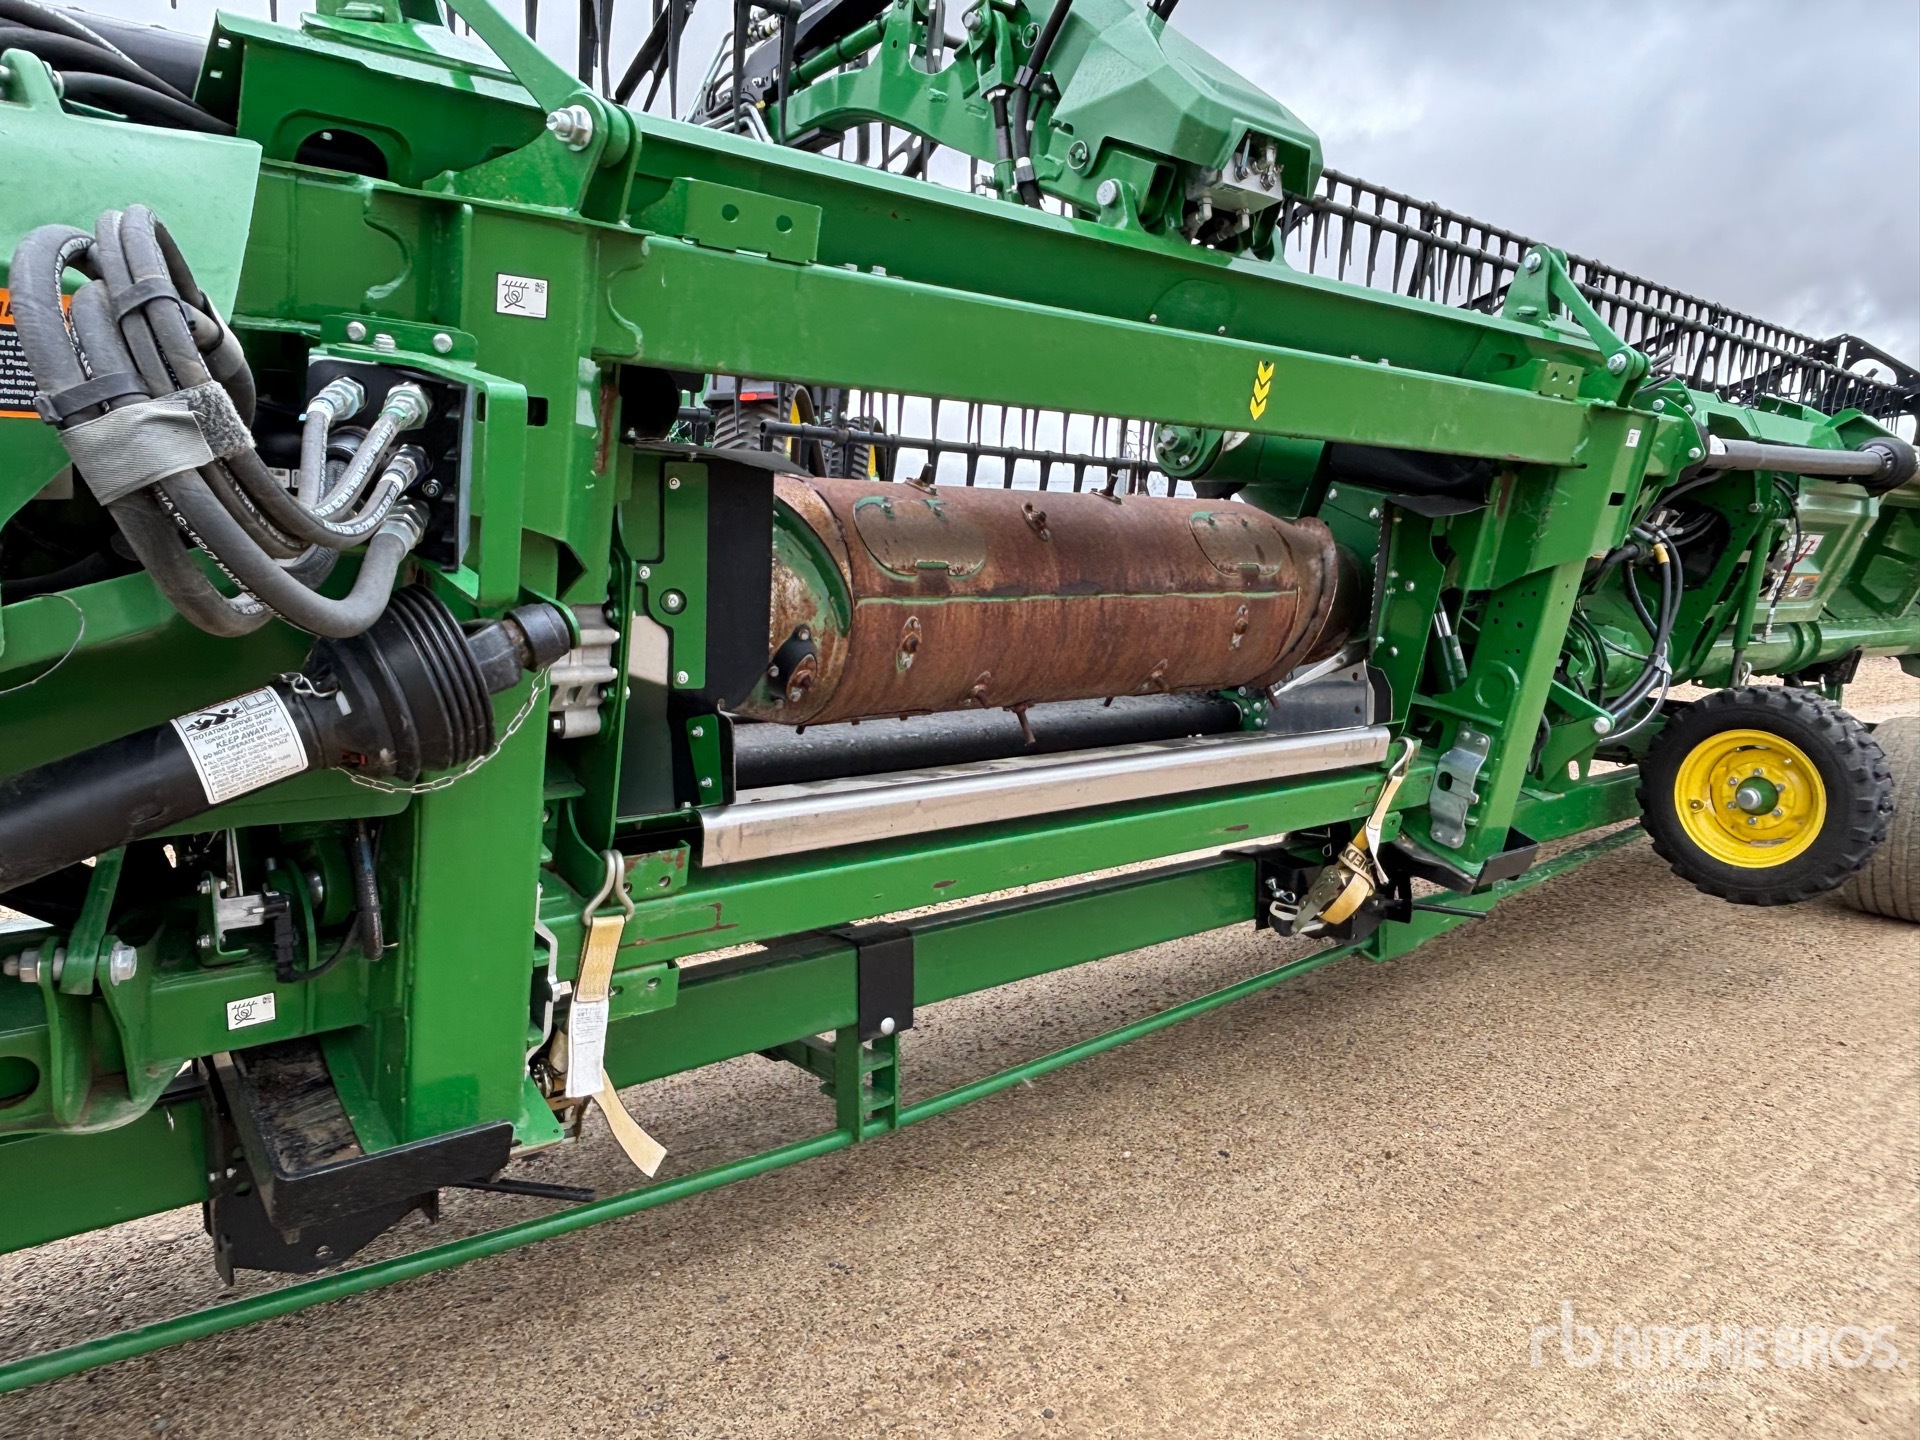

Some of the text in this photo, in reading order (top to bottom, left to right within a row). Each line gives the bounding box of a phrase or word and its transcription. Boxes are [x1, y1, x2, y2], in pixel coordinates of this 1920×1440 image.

[192, 707, 278, 742] ROTATING DRIVE SHAFT
[205, 717, 272, 744] CONTACT CAN CAUSE DEATH
[215, 725, 268, 748] KEEP AWAY!
[213, 748, 226, 756] NOT
[227, 737, 256, 751] OPERATE
